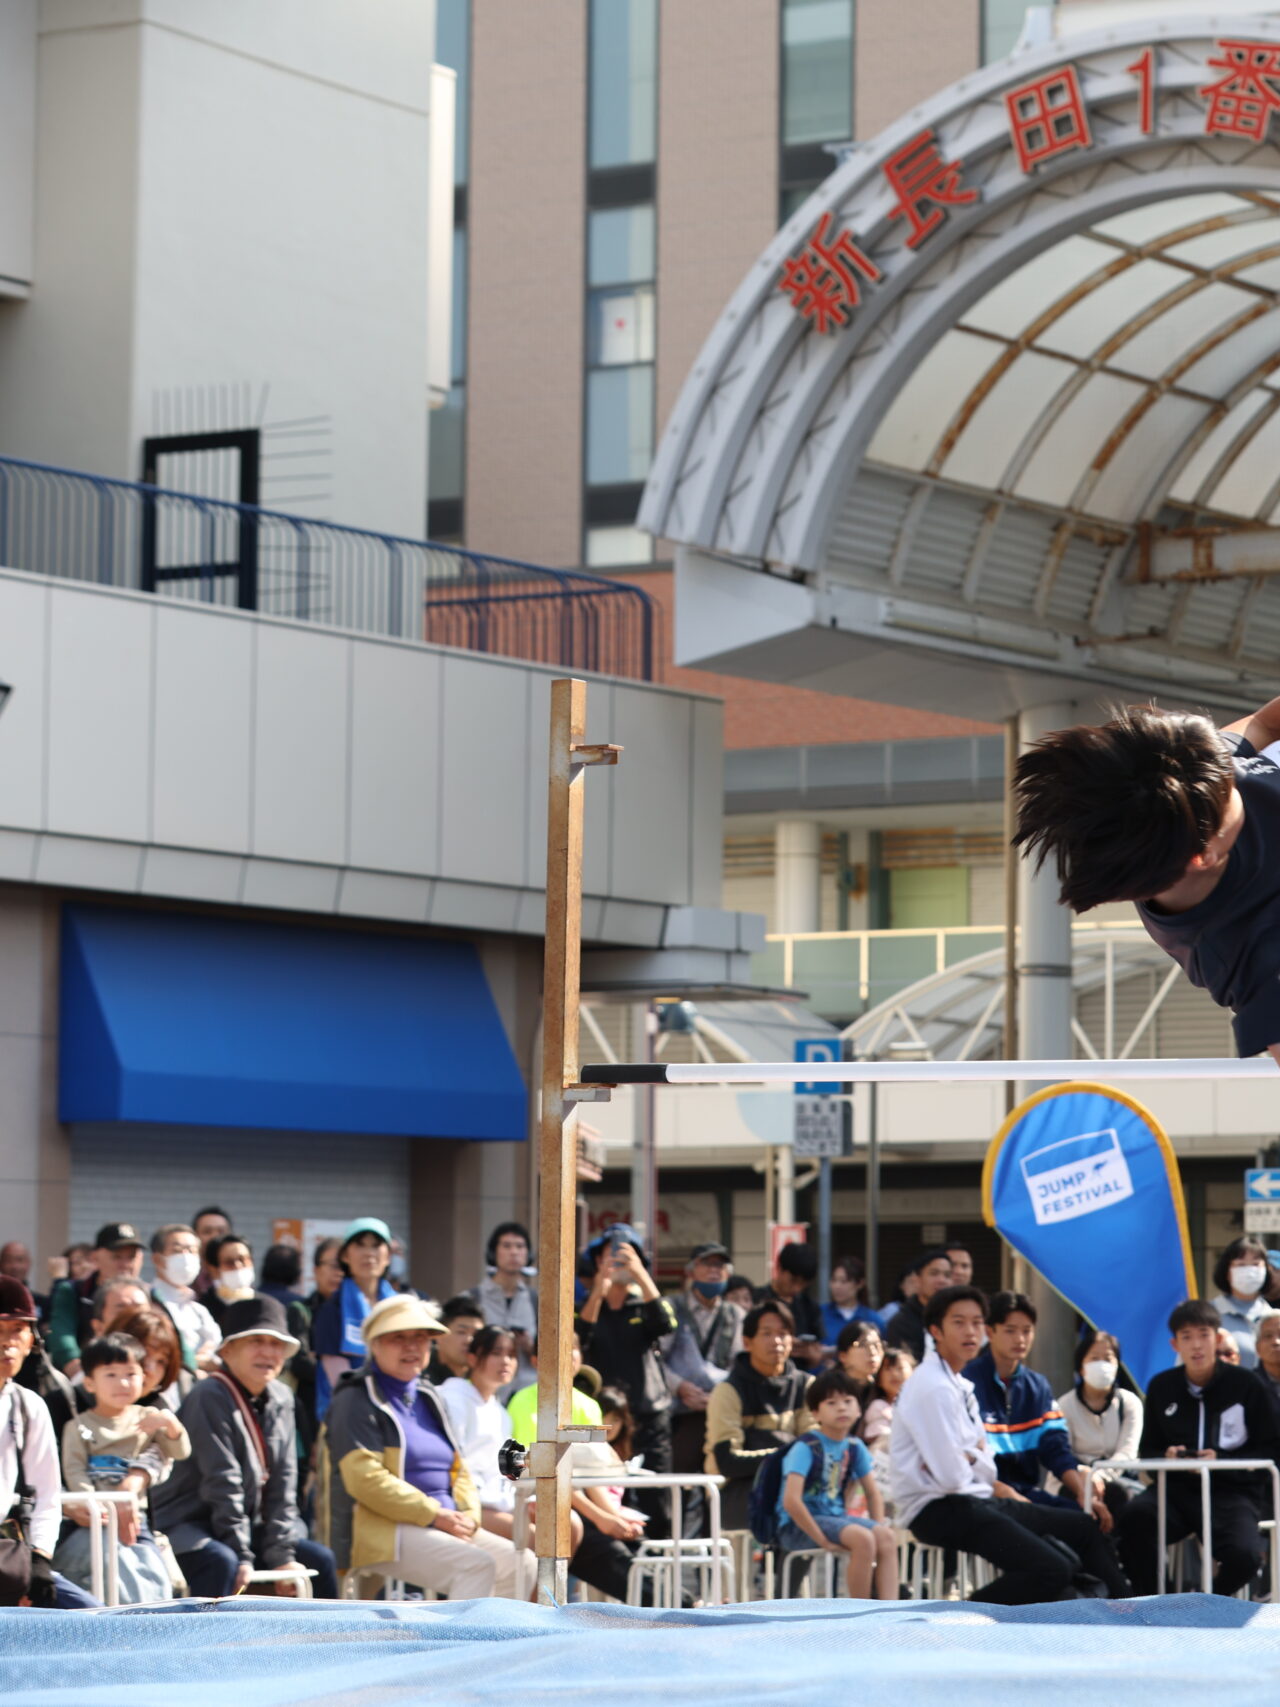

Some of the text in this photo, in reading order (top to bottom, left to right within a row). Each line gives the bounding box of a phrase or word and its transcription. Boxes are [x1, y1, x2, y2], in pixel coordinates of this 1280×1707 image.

[805, 1044, 834, 1091] P
[1037, 1171, 1087, 1199] JUMP
[1041, 1179, 1123, 1216] FESTIVAL
